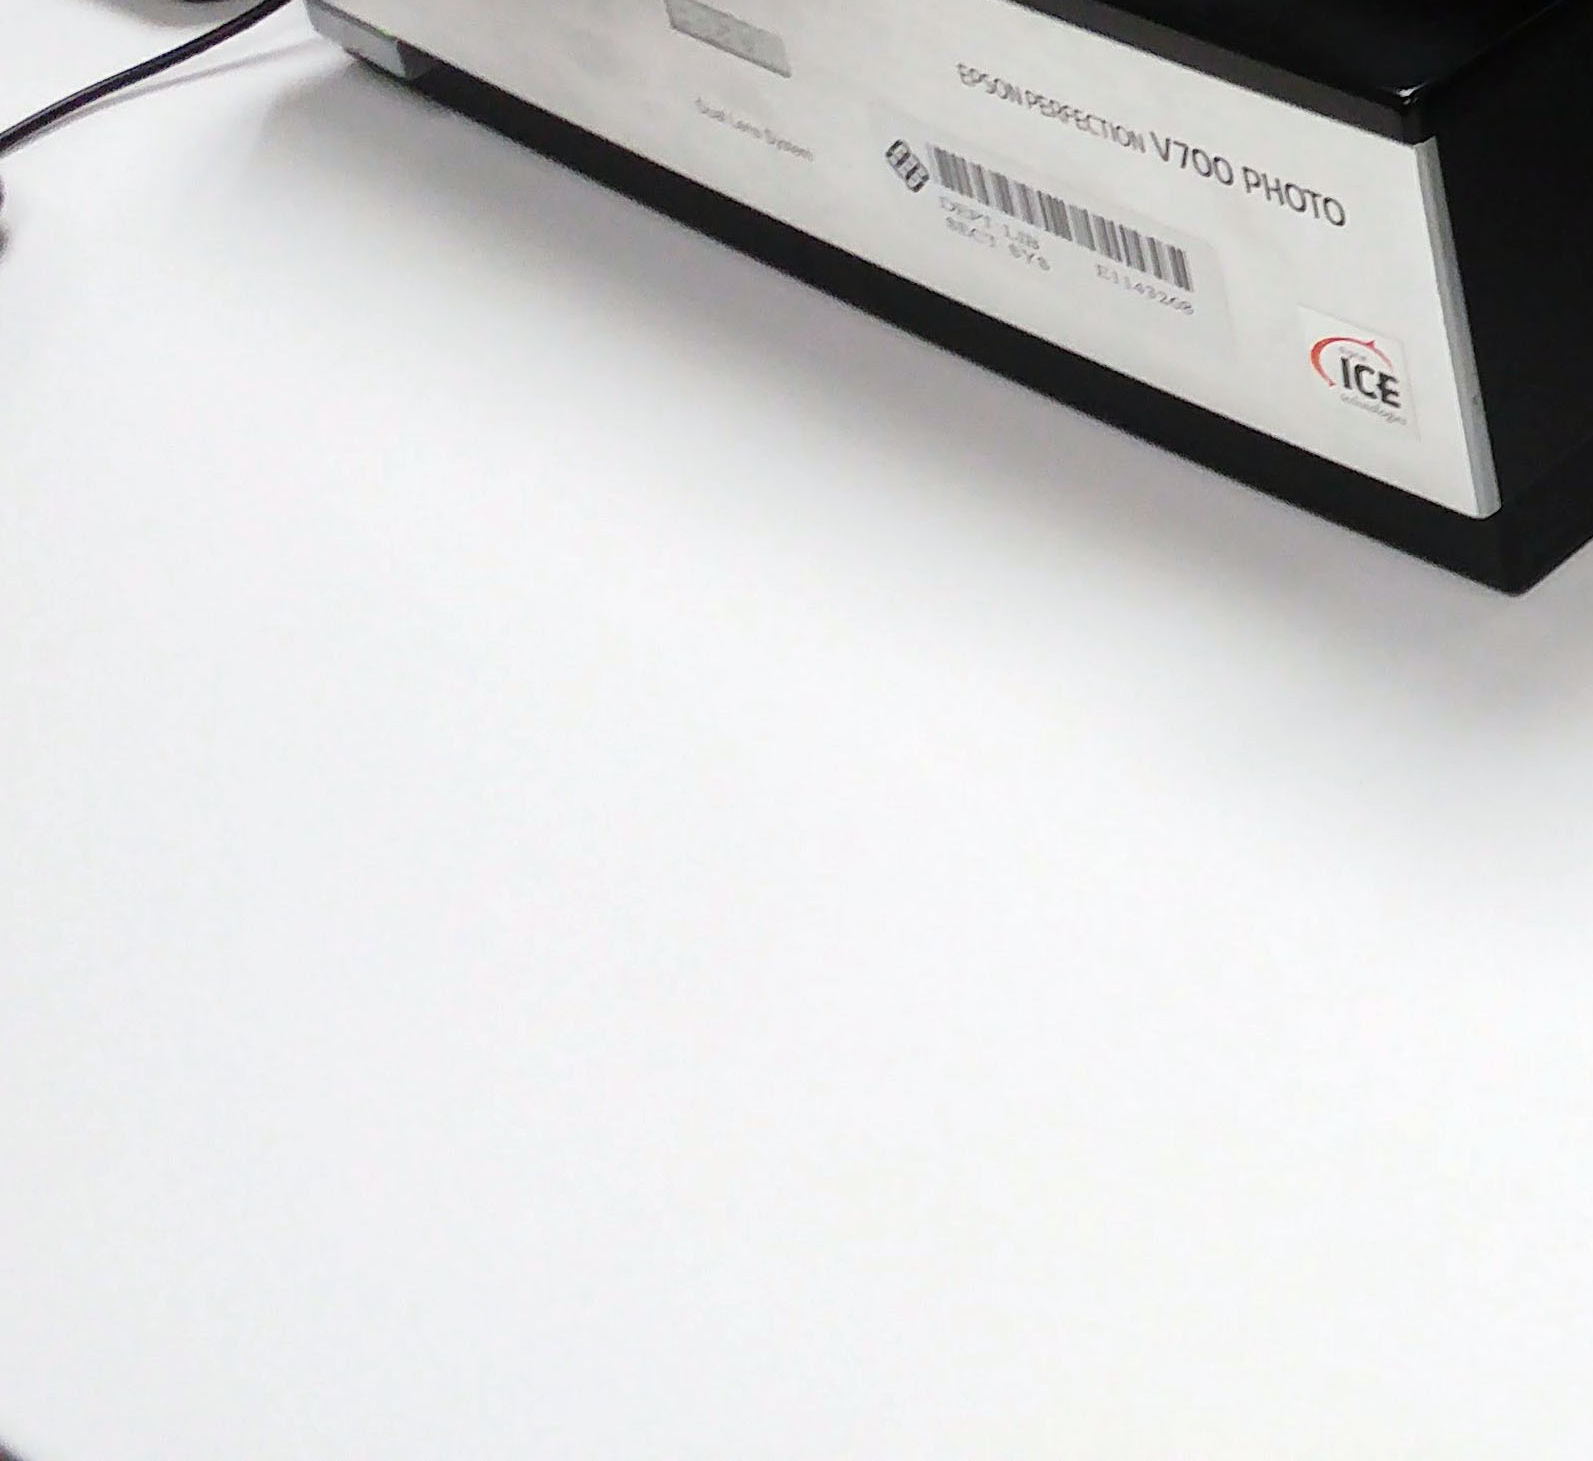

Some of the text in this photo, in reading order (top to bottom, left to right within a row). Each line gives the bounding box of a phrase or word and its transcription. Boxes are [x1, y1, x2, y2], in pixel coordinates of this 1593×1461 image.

[955, 62, 1347, 228] EPSON PERFECTION V700 PHOTO
[1340, 356, 1402, 409] ICE
